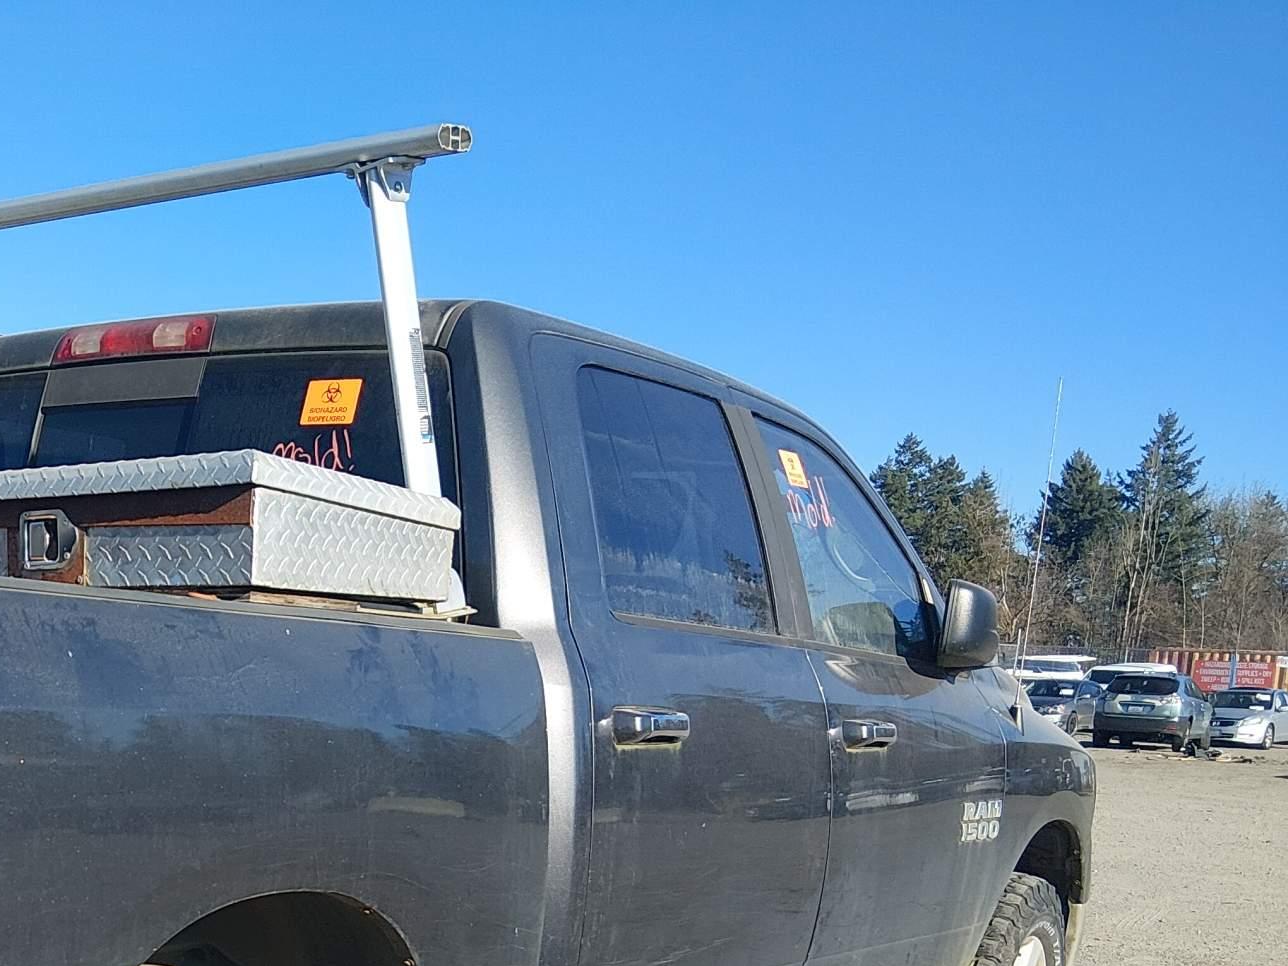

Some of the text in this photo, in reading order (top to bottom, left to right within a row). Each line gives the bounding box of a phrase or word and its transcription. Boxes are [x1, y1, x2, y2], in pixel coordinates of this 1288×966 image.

[309, 406, 348, 414] BIOHAZARD
[963, 800, 1003, 821] RAM
[961, 820, 1000, 842] 1500
